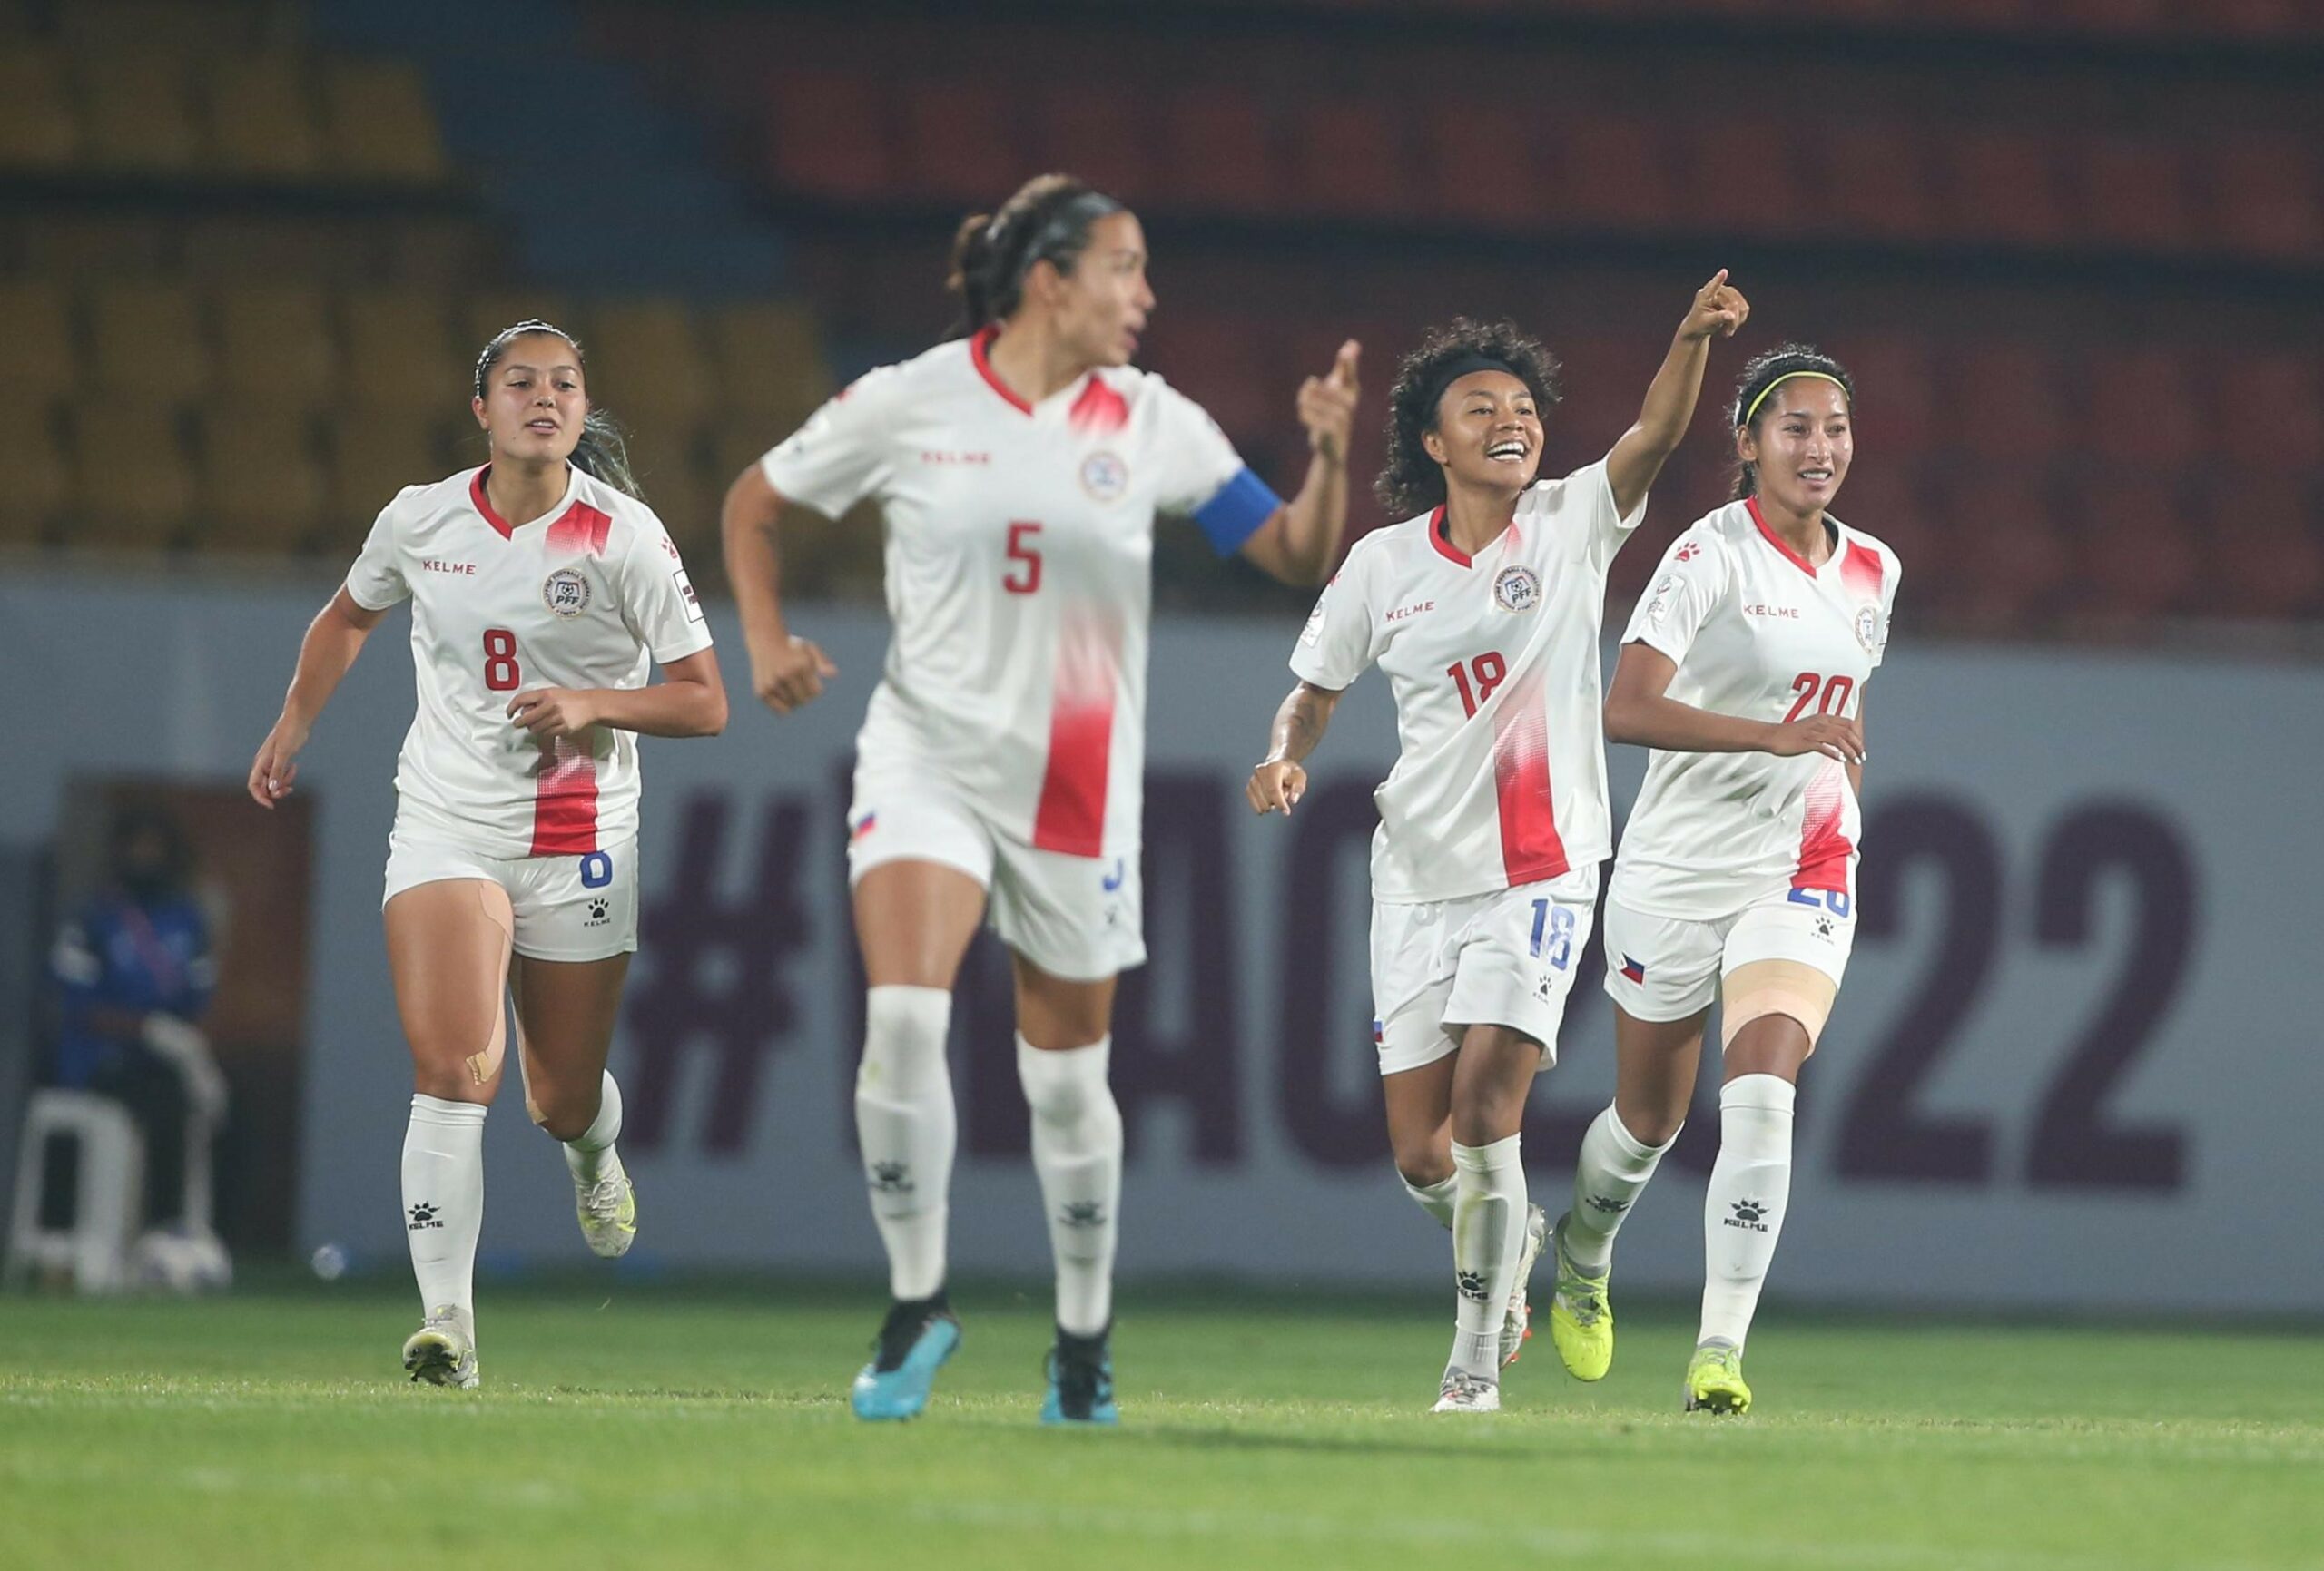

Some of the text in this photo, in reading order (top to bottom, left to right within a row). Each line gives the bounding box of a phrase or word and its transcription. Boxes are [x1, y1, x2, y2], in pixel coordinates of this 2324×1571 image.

[422, 560, 477, 575] KELME
[1003, 522, 1042, 596] 5
[556, 594, 580, 605] PFF
[1512, 586, 1531, 604] PFF
[1385, 601, 1435, 622] KELME
[1743, 604, 1800, 619] KELME
[483, 628, 520, 692] 8
[1446, 651, 1507, 721] 18
[1782, 672, 1855, 724] 20
[1529, 898, 1575, 972] 18
[1724, 1217, 1768, 1232] KELME
